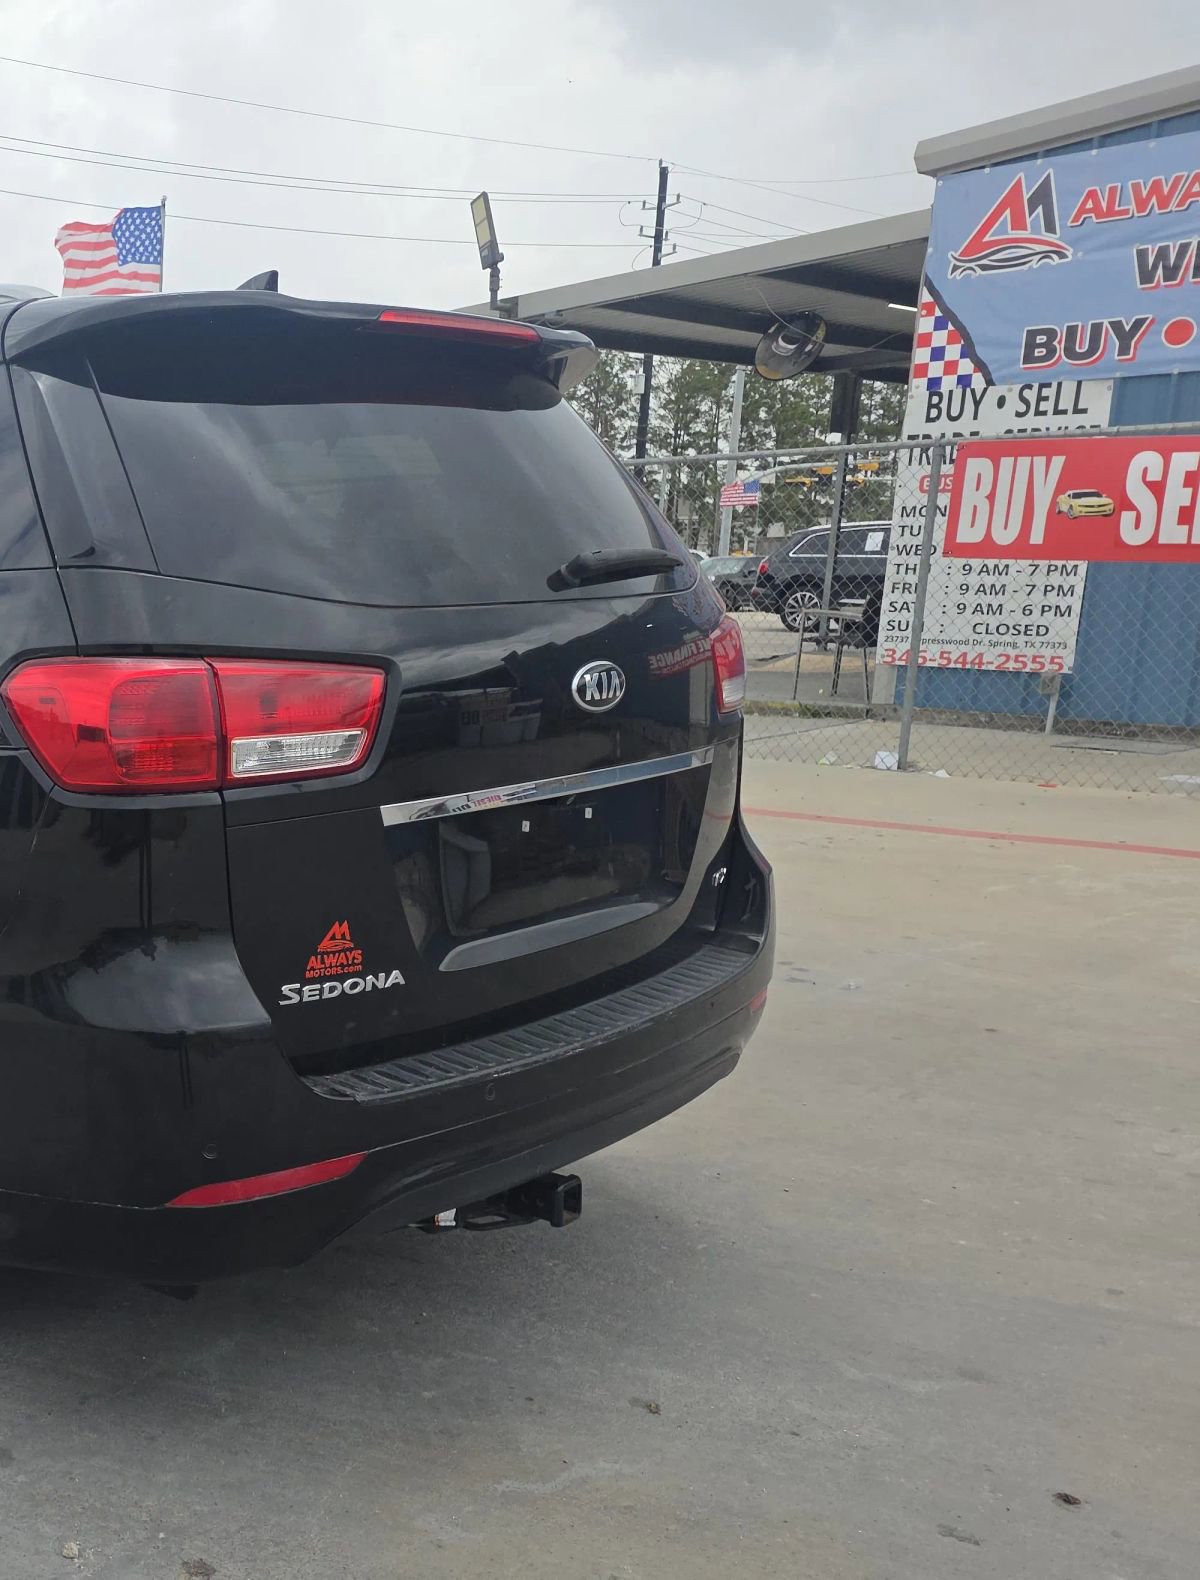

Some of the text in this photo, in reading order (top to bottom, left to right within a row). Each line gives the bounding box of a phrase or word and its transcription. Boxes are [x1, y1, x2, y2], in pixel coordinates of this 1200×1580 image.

[1134, 238, 1200, 291] W
[1020, 314, 1156, 371] BUY
[925, 380, 1089, 423] BUY SELL
[956, 451, 1200, 546] BUY SE
[898, 525, 922, 537] TU
[894, 563, 931, 576] TH
[962, 563, 972, 576] 9
[977, 563, 1010, 576] AM
[1028, 564, 1040, 577] 7
[1046, 564, 1079, 577] PM
[959, 583, 970, 596] 9
[974, 583, 1007, 596] AM
[1025, 584, 1037, 597] 7
[1043, 584, 1076, 597] PM
[956, 602, 967, 615] 9
[971, 603, 1003, 616] AM
[1022, 604, 1033, 617] 6
[1040, 604, 1073, 618] PM
[886, 620, 924, 632] SU
[972, 622, 1050, 637] CLOSED
[922, 637, 970, 646] presswood
[1024, 641, 1036, 649] TX
[1039, 641, 1068, 650] 77373
[583, 670, 621, 701] KIA
[307, 949, 363, 970] ALWAYS
[305, 965, 363, 978] MOTORS.com
[278, 970, 406, 1005] SEDONA
